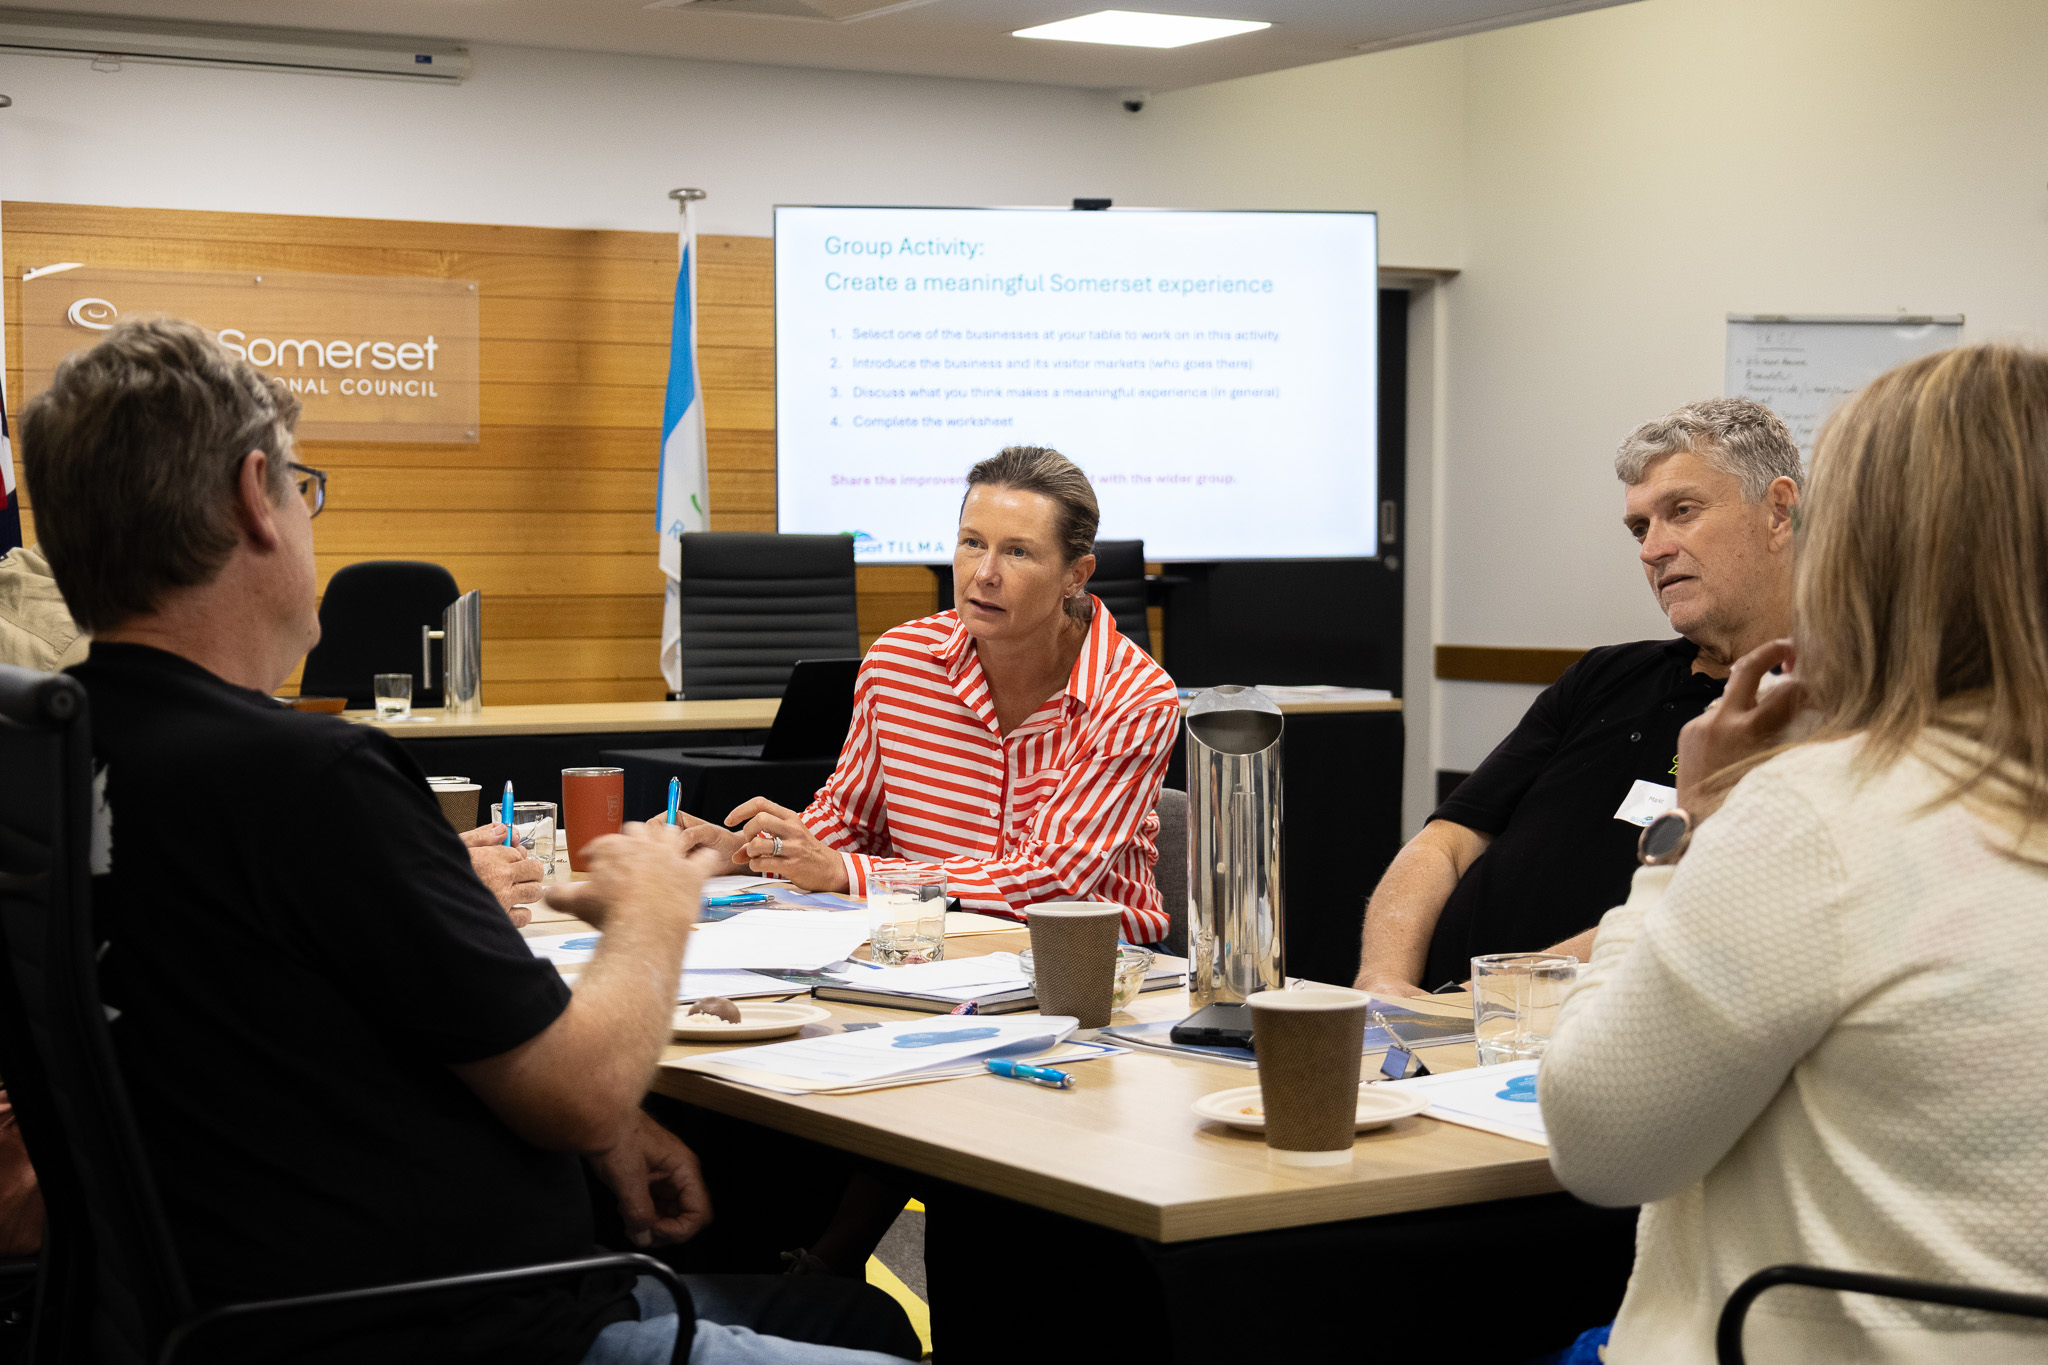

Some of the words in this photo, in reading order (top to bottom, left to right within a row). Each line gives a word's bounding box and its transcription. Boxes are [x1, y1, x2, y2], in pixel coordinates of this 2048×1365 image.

[824, 235, 893, 260] Group
[898, 236, 985, 261] Activity:
[824, 271, 898, 293] Create
[904, 277, 917, 293] a
[923, 272, 1045, 297] meaningful
[1050, 273, 1152, 294] Somerset
[1158, 274, 1274, 297] experience
[830, 328, 842, 340] 1.
[852, 328, 894, 340] Select
[897, 330, 922, 340] one
[925, 328, 940, 340] of
[942, 328, 962, 340] the
[965, 328, 1039, 340] businesses
[1042, 329, 1055, 341] at
[1057, 331, 1086, 343] your
[1089, 329, 1121, 341] table
[1125, 329, 1137, 341] to
[1140, 329, 1170, 341] work
[1174, 331, 1190, 341] on
[1193, 329, 1204, 341] in
[1208, 329, 1231, 341] this
[217, 328, 438, 371] Somerset
[830, 357, 842, 369] 2.
[852, 357, 917, 369] Introduce
[920, 357, 940, 369] the
[944, 357, 1002, 369] business
[1006, 357, 1029, 369] and
[1033, 357, 1049, 369] its
[1052, 357, 1090, 369] visitor
[1093, 358, 1146, 370] markets
[1149, 358, 1179, 372] (who
[1183, 360, 1212, 372] goes
[1216, 358, 1253, 372] there)
[340, 378, 438, 397] COUNCIL
[830, 386, 842, 398] 3.
[852, 386, 905, 399] Discuss
[908, 386, 940, 399] what
[944, 388, 967, 401] you
[970, 386, 1002, 399] think
[1006, 386, 1048, 399] makes
[1052, 388, 1060, 399] a
[1063, 386, 1134, 401] meaningful
[1138, 386, 1207, 401] experience
[1230, 386, 1280, 401] general)
[830, 415, 842, 427] 4.
[852, 415, 919, 429] Complete
[922, 415, 943, 427] the
[945, 415, 1014, 427] worksheet
[831, 474, 871, 486] Share
[875, 474, 897, 486] the
[1099, 473, 1127, 484] with
[1131, 473, 1151, 484] the
[1156, 473, 1191, 484] wider
[1196, 475, 1236, 486] group.
[888, 541, 945, 553] TILMA
